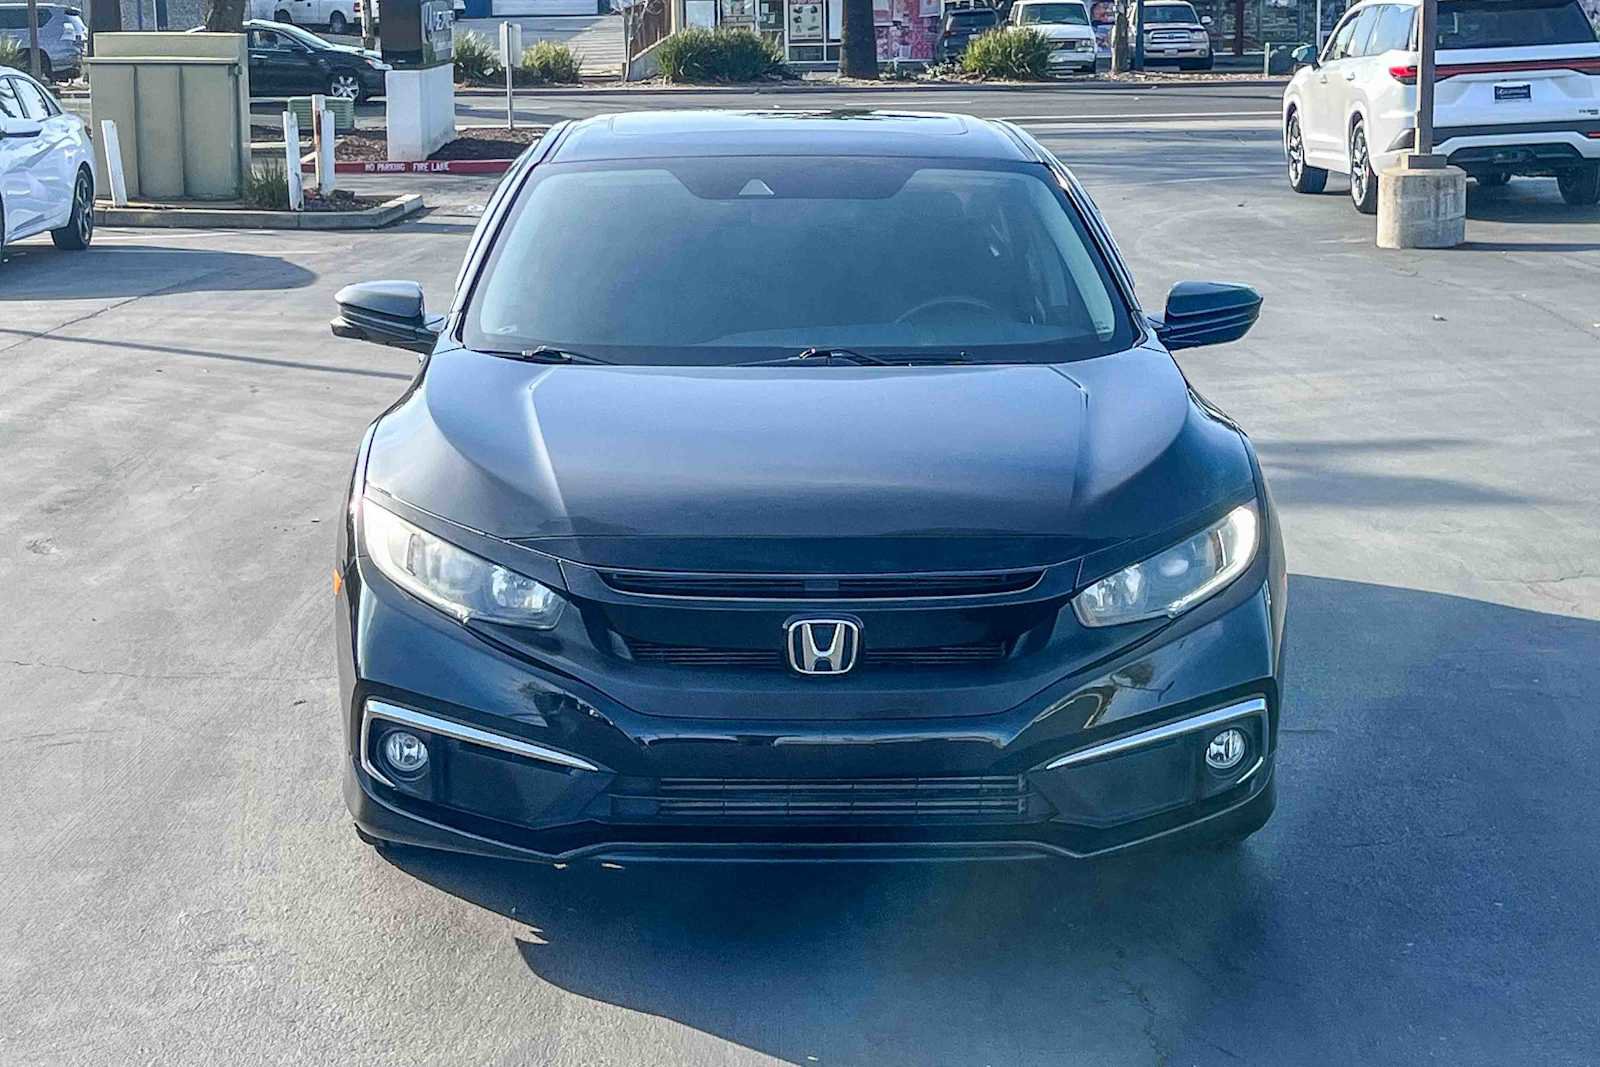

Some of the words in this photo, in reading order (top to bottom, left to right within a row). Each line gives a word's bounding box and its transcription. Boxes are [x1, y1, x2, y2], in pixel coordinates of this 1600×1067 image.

[364, 162, 375, 172] NO
[377, 162, 406, 172] PARKING
[412, 162, 429, 172] FIRE
[431, 161, 450, 171] LANE
